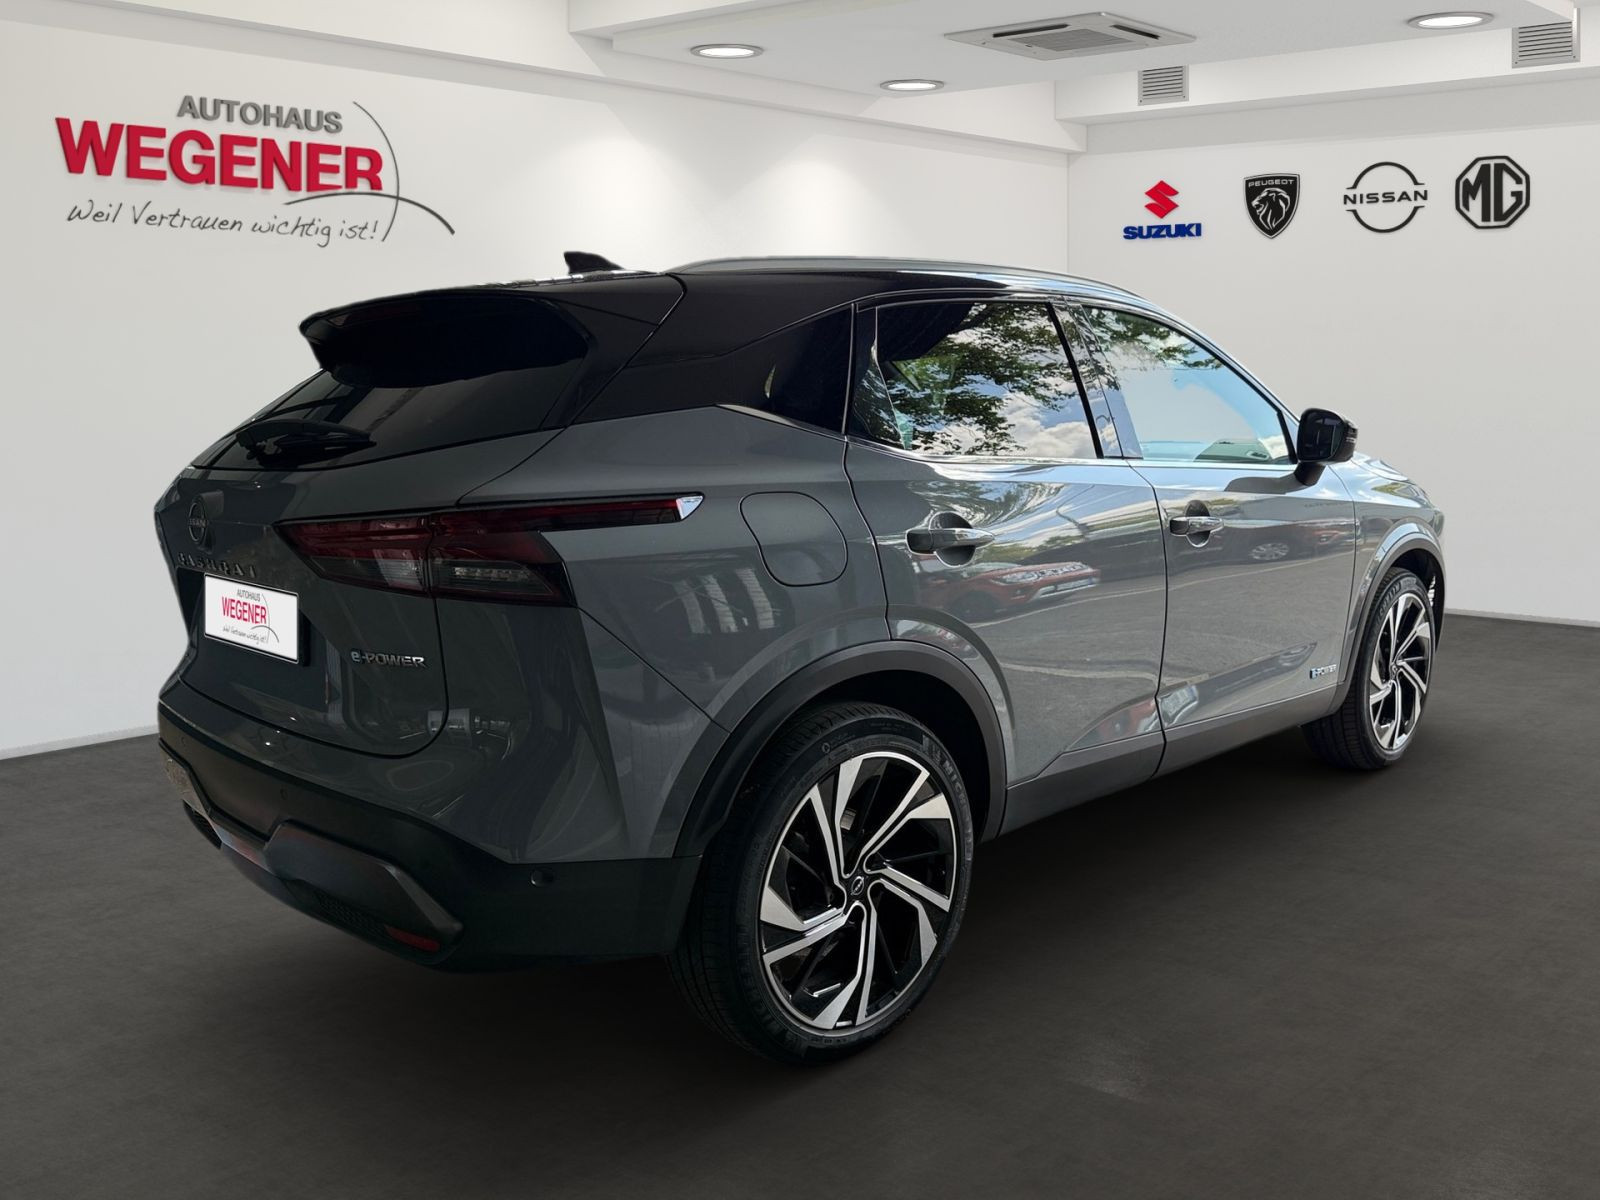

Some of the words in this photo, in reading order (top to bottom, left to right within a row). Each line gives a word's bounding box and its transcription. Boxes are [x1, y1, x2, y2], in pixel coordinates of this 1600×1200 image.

[177, 95, 343, 133] AUTOHAUS
[55, 117, 383, 193] WEGENER
[1248, 178, 1295, 188] PEUGEOT
[1460, 161, 1524, 223] MG
[1343, 189, 1428, 206] NISSAN
[67, 199, 123, 223] Weil
[132, 200, 243, 232] Vertrauen
[251, 215, 331, 248] wichtig
[339, 220, 378, 240] ist!
[1123, 222, 1202, 240] SUZUKI
[237, 589, 261, 602] AUTOHAUS
[221, 596, 267, 625] WEGENER
[350, 650, 428, 668] e-POWER
